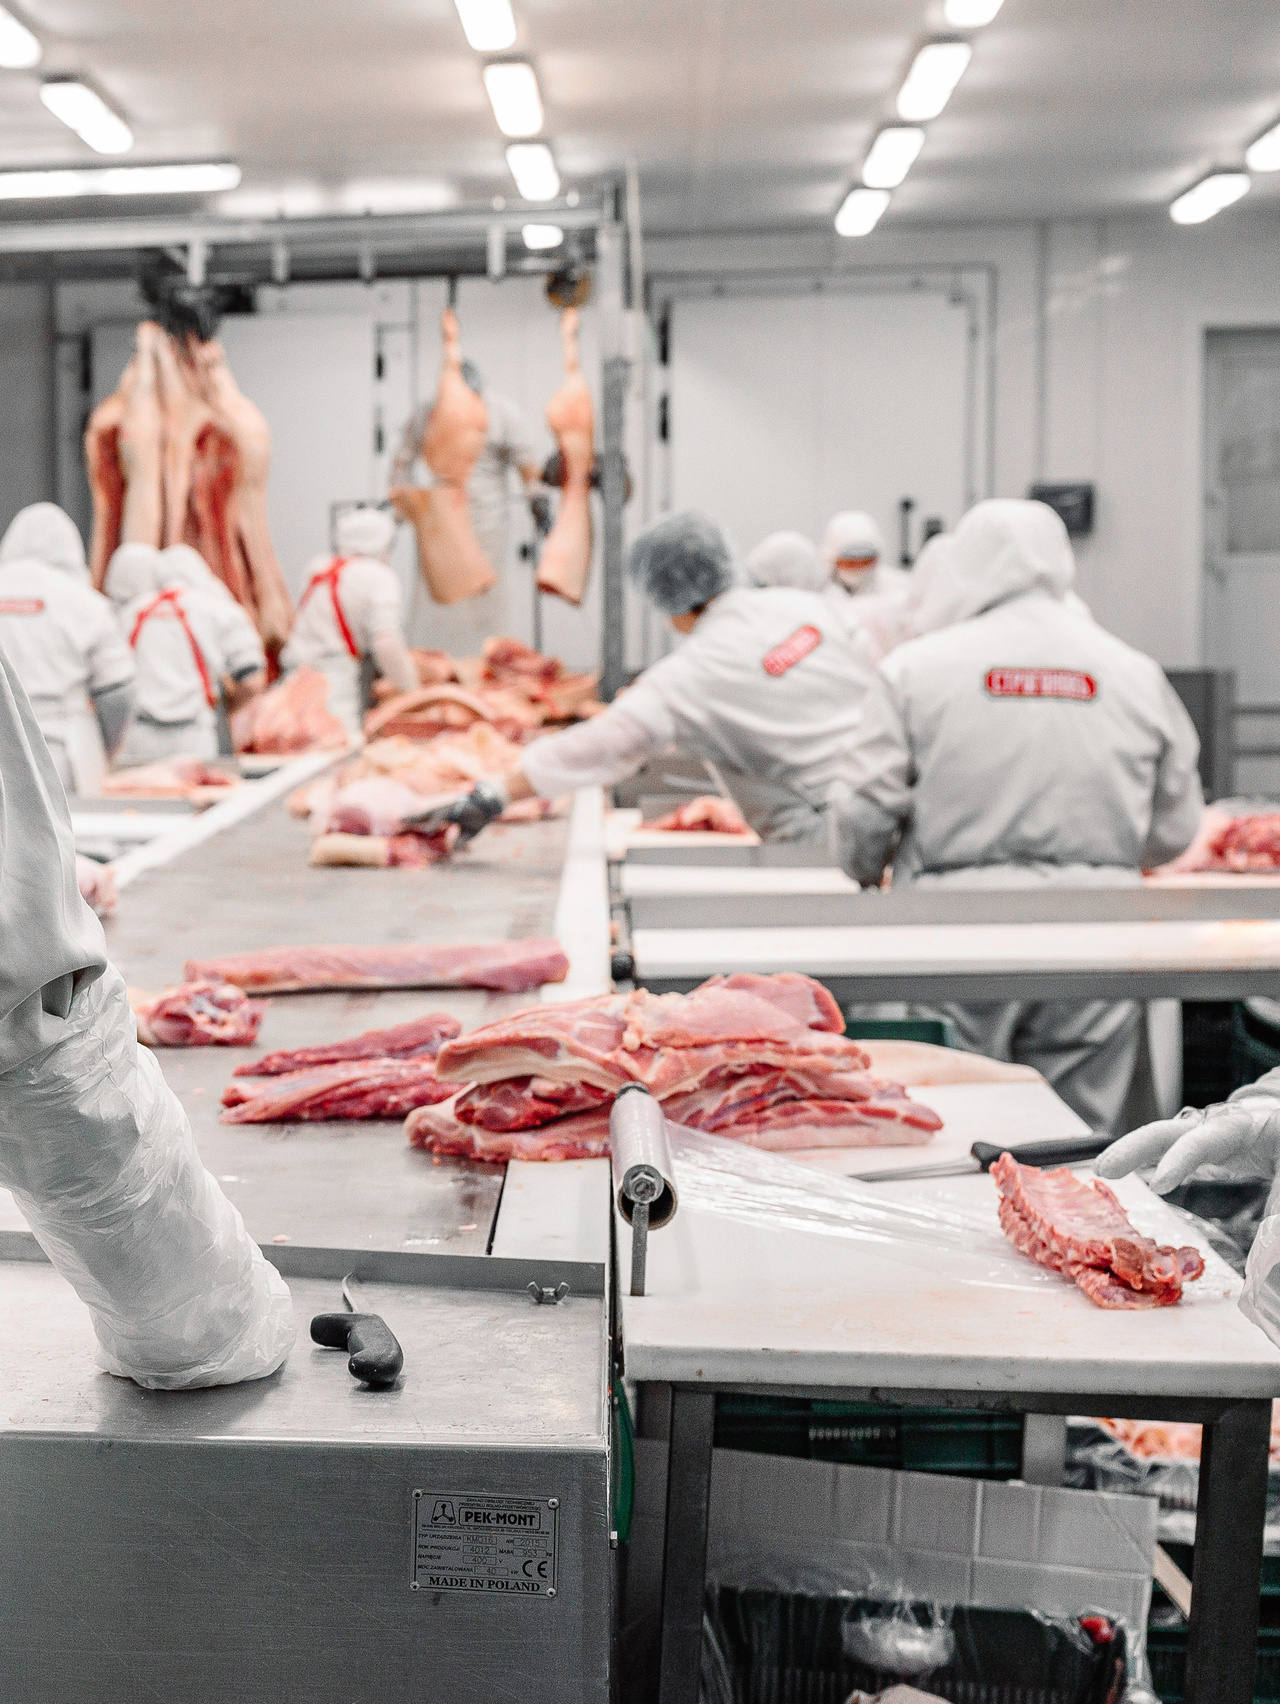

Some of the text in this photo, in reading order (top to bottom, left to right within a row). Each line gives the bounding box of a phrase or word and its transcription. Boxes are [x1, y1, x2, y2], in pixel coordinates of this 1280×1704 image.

[464, 1511, 536, 1527] PEK-MONT
[522, 1559, 548, 1579] CE
[429, 1576, 541, 1592] MADE IN POLAND
